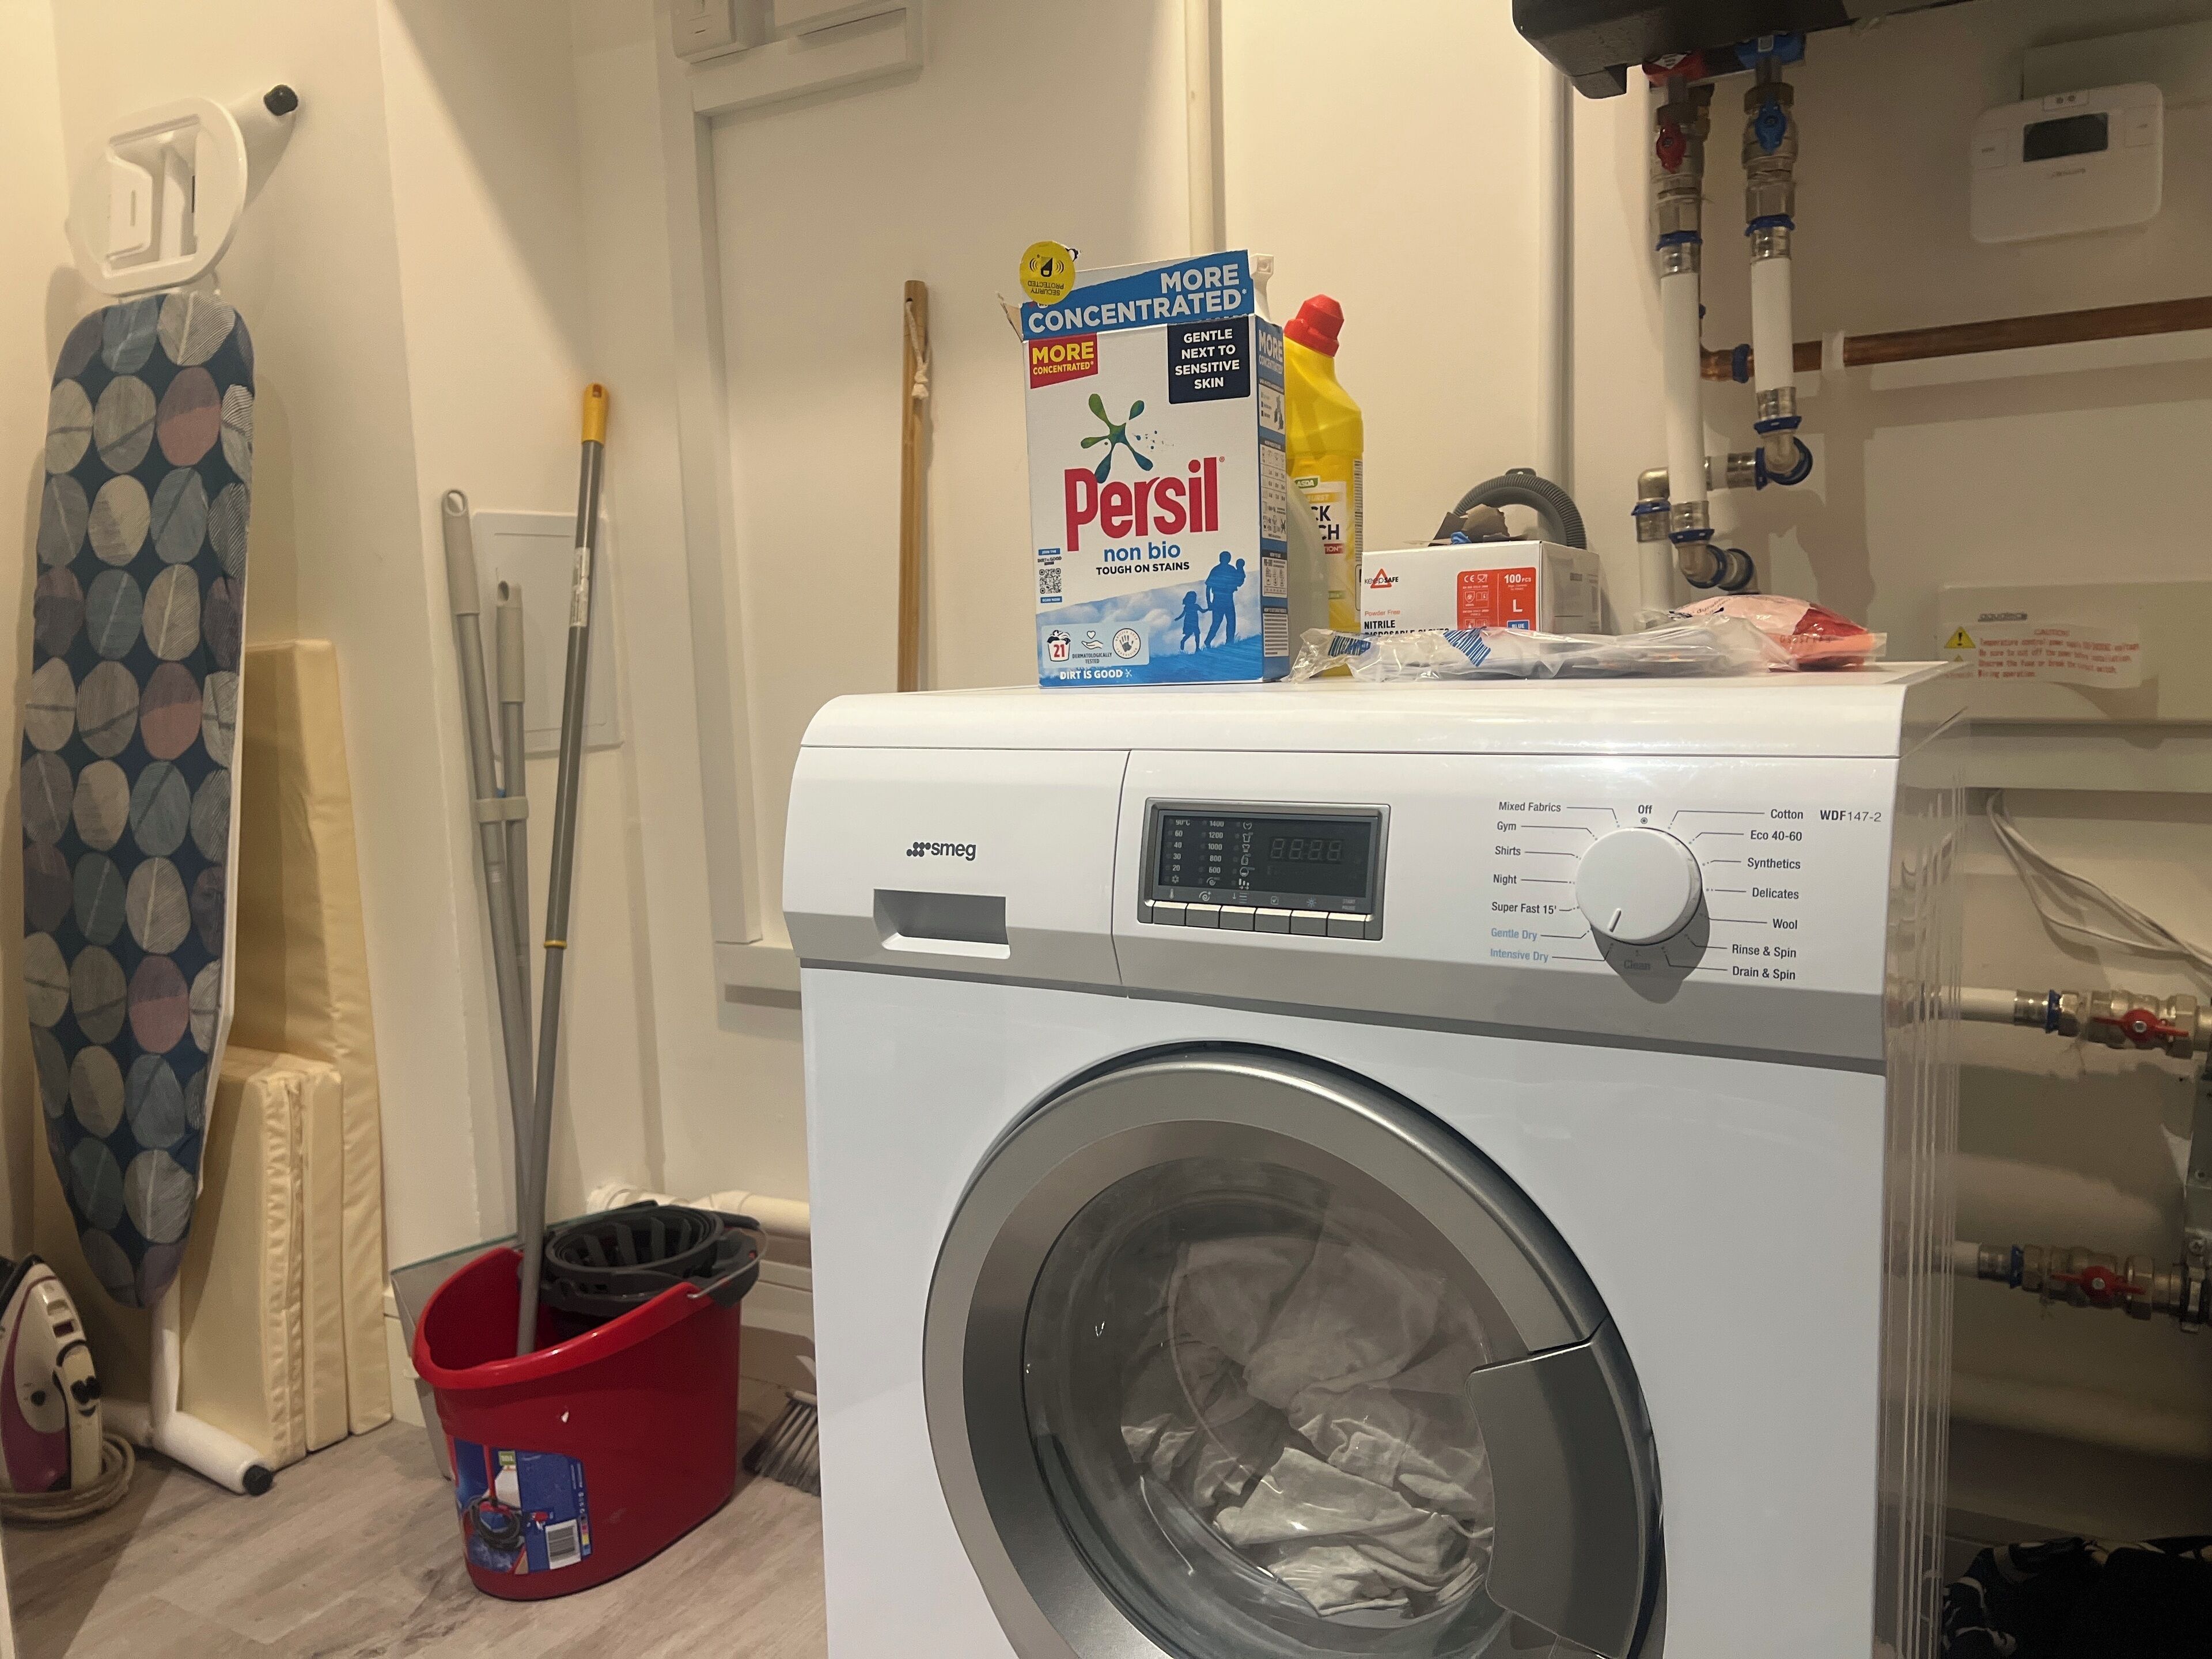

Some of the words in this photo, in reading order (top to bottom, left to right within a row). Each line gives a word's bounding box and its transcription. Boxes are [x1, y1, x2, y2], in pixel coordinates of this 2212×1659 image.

[1027, 280, 1065, 290] PROTECTED
[1160, 263, 1239, 294] MORE
[1030, 287, 1060, 296] SECURITY
[1183, 328, 1233, 344] GENTLE
[1181, 346, 1215, 359] NEXT
[1218, 344, 1236, 355] TO
[1258, 329, 1283, 363] MORE
[1032, 341, 1094, 365] MORE
[1175, 359, 1240, 376] SENSITIVE
[1194, 376, 1224, 390] SKIN
[1104, 547, 1142, 563] non
[1147, 540, 1181, 559] bio
[1096, 565, 1132, 575] TOUGH
[1134, 563, 1150, 573] ON
[1152, 562, 1190, 572] STAINS
[1512, 599, 1523, 613] L
[1363, 619, 1396, 630] NITRILE
[1053, 644, 1065, 658] 21
[1059, 669, 1082, 680] DIRT
[1083, 669, 1092, 680] IS
[1094, 669, 1123, 679] GOOD
[1498, 801, 1526, 812] Mixed
[1528, 802, 1562, 812] Fabrics
[1638, 804, 1653, 815] Off
[1770, 809, 1804, 820] Cotton
[1820, 809, 1882, 823] WDF147-2
[1497, 821, 1517, 833] Gym
[1750, 830, 1769, 840] Eco
[1771, 831, 1802, 842] 40-60
[930, 842, 977, 862] smeg
[1494, 846, 1522, 856] Shirts
[1747, 857, 1801, 870] Synthetics
[1493, 874, 1517, 886] Night
[1752, 887, 1800, 899] Delicates
[1491, 902, 1518, 914] Super
[1521, 903, 1540, 914] Fast
[1543, 904, 1556, 915] 15'
[1772, 918, 1798, 930] Wool
[1491, 927, 1519, 938] Gentle
[1522, 929, 1537, 942] Dry
[1490, 948, 1531, 960] Intensive
[1533, 950, 1549, 963] Dry
[1732, 944, 1760, 956] Rinse
[1763, 946, 1771, 956] &
[1774, 946, 1797, 959] Spin
[1732, 965, 1759, 978] Drain
[1762, 968, 1770, 978] &
[1772, 968, 1796, 981] Spin
